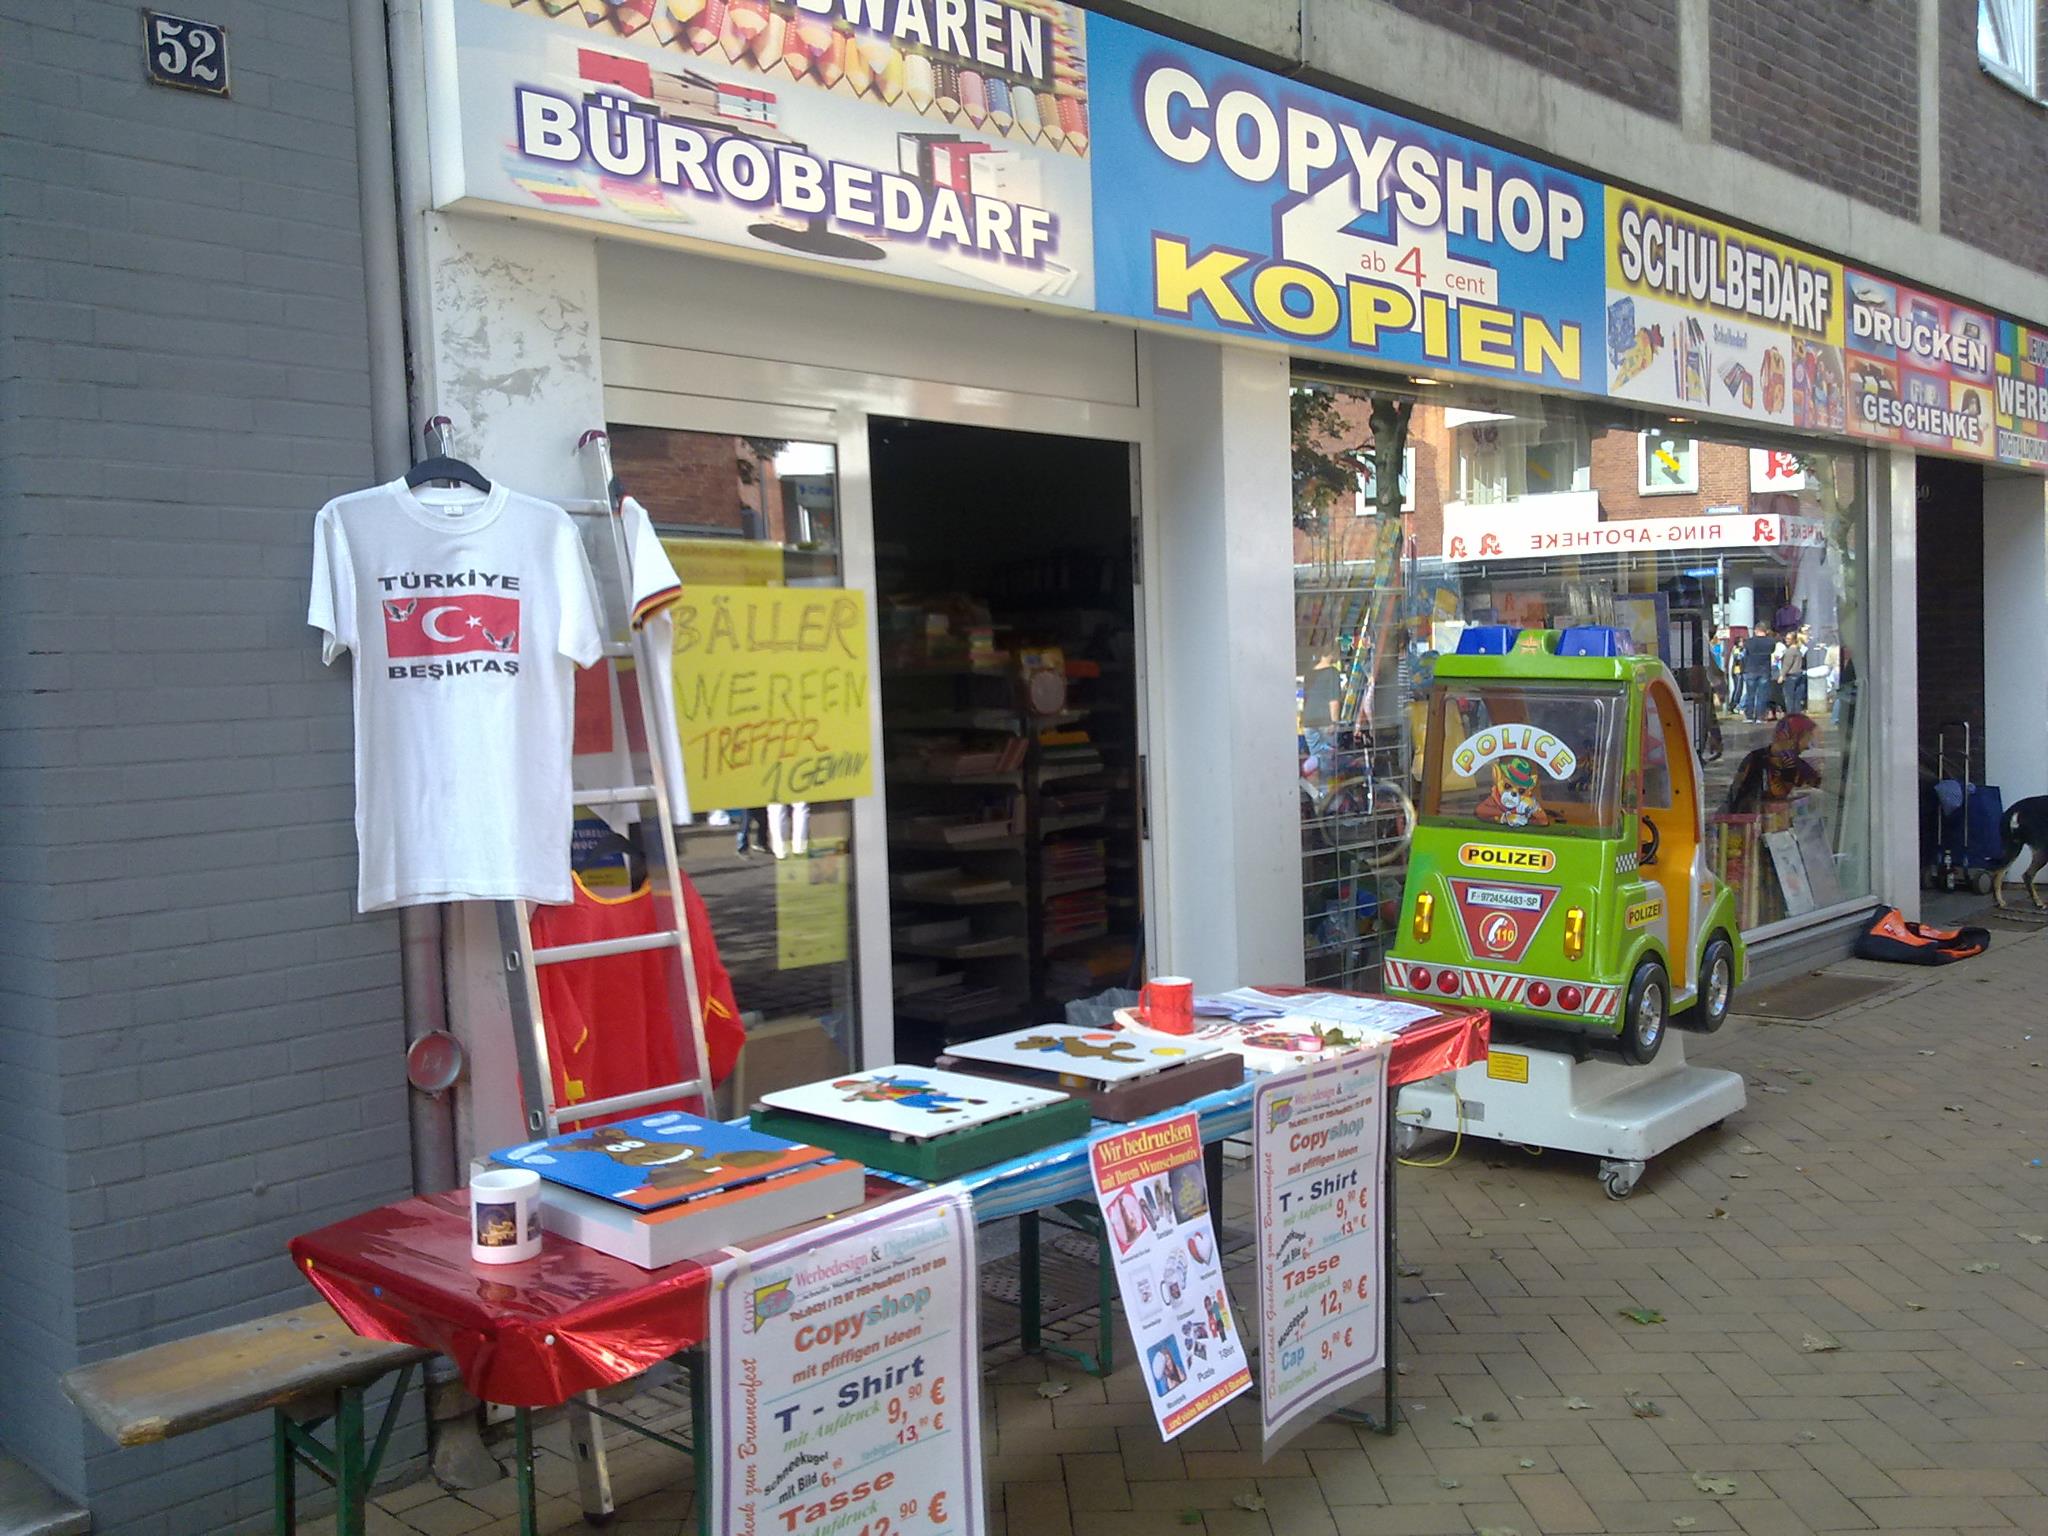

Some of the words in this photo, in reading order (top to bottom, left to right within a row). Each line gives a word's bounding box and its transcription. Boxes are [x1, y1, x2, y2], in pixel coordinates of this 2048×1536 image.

[155, 24, 219, 83] 52
[520, 88, 1051, 259] BÜROBEDARF
[1144, 67, 1585, 261] COPYSHOP
[1360, 250, 1386, 273] ab
[1394, 246, 1427, 288] 4
[1444, 271, 1485, 296] cent
[1620, 209, 1830, 332] SCHULBEDARF
[1154, 237, 1581, 382] KOPIEN
[1853, 303, 1988, 373] DRUCKEN
[1862, 394, 1980, 442] GESCHENKE
[377, 568, 521, 592] TÜRKİYE
[670, 593, 860, 660] BÄLLER
[387, 659, 520, 681] BEŞİKTAŞ
[673, 666, 868, 722] WERFEN
[688, 717, 830, 781] TREFFER
[1455, 728, 1574, 776] POLICE
[762, 761, 784, 803] 1
[1467, 847, 1548, 868] POLIZEI
[1496, 928, 1515, 942] 110
[1628, 903, 1662, 924] POLIZEI
[1098, 1140, 1122, 1163] Wir
[1122, 1121, 1192, 1157] bedrucken
[1289, 1117, 1364, 1153] Copyshop
[1279, 1191, 1292, 1213] T
[1310, 1168, 1358, 1200] Shirt
[1359, 1186, 1368, 1209] €
[795, 1254, 867, 1287] Werbedesign
[871, 1246, 881, 1262] &
[1282, 1254, 1341, 1291] Tasse
[1357, 1274, 1368, 1300] €
[794, 1284, 932, 1352] Copyshop
[1344, 1326, 1353, 1348] €
[792, 1363, 817, 1384] mit
[821, 1341, 880, 1376] pfiffigen
[884, 1324, 922, 1348] Ideen
[1281, 1346, 1305, 1371] Cap
[737, 1358, 763, 1460] Brunnenfest
[774, 1404, 800, 1434] T
[837, 1354, 925, 1409] Shirt
[930, 1376, 946, 1405] €
[783, 1430, 810, 1453] mit
[813, 1401, 882, 1442] Aufdruck
[932, 1411, 944, 1431] €
[745, 1463, 763, 1496] zum
[778, 1487, 796, 1505] mit
[797, 1471, 818, 1494] Bild
[778, 1470, 896, 1534] Tasse
[927, 1489, 949, 1525] €
